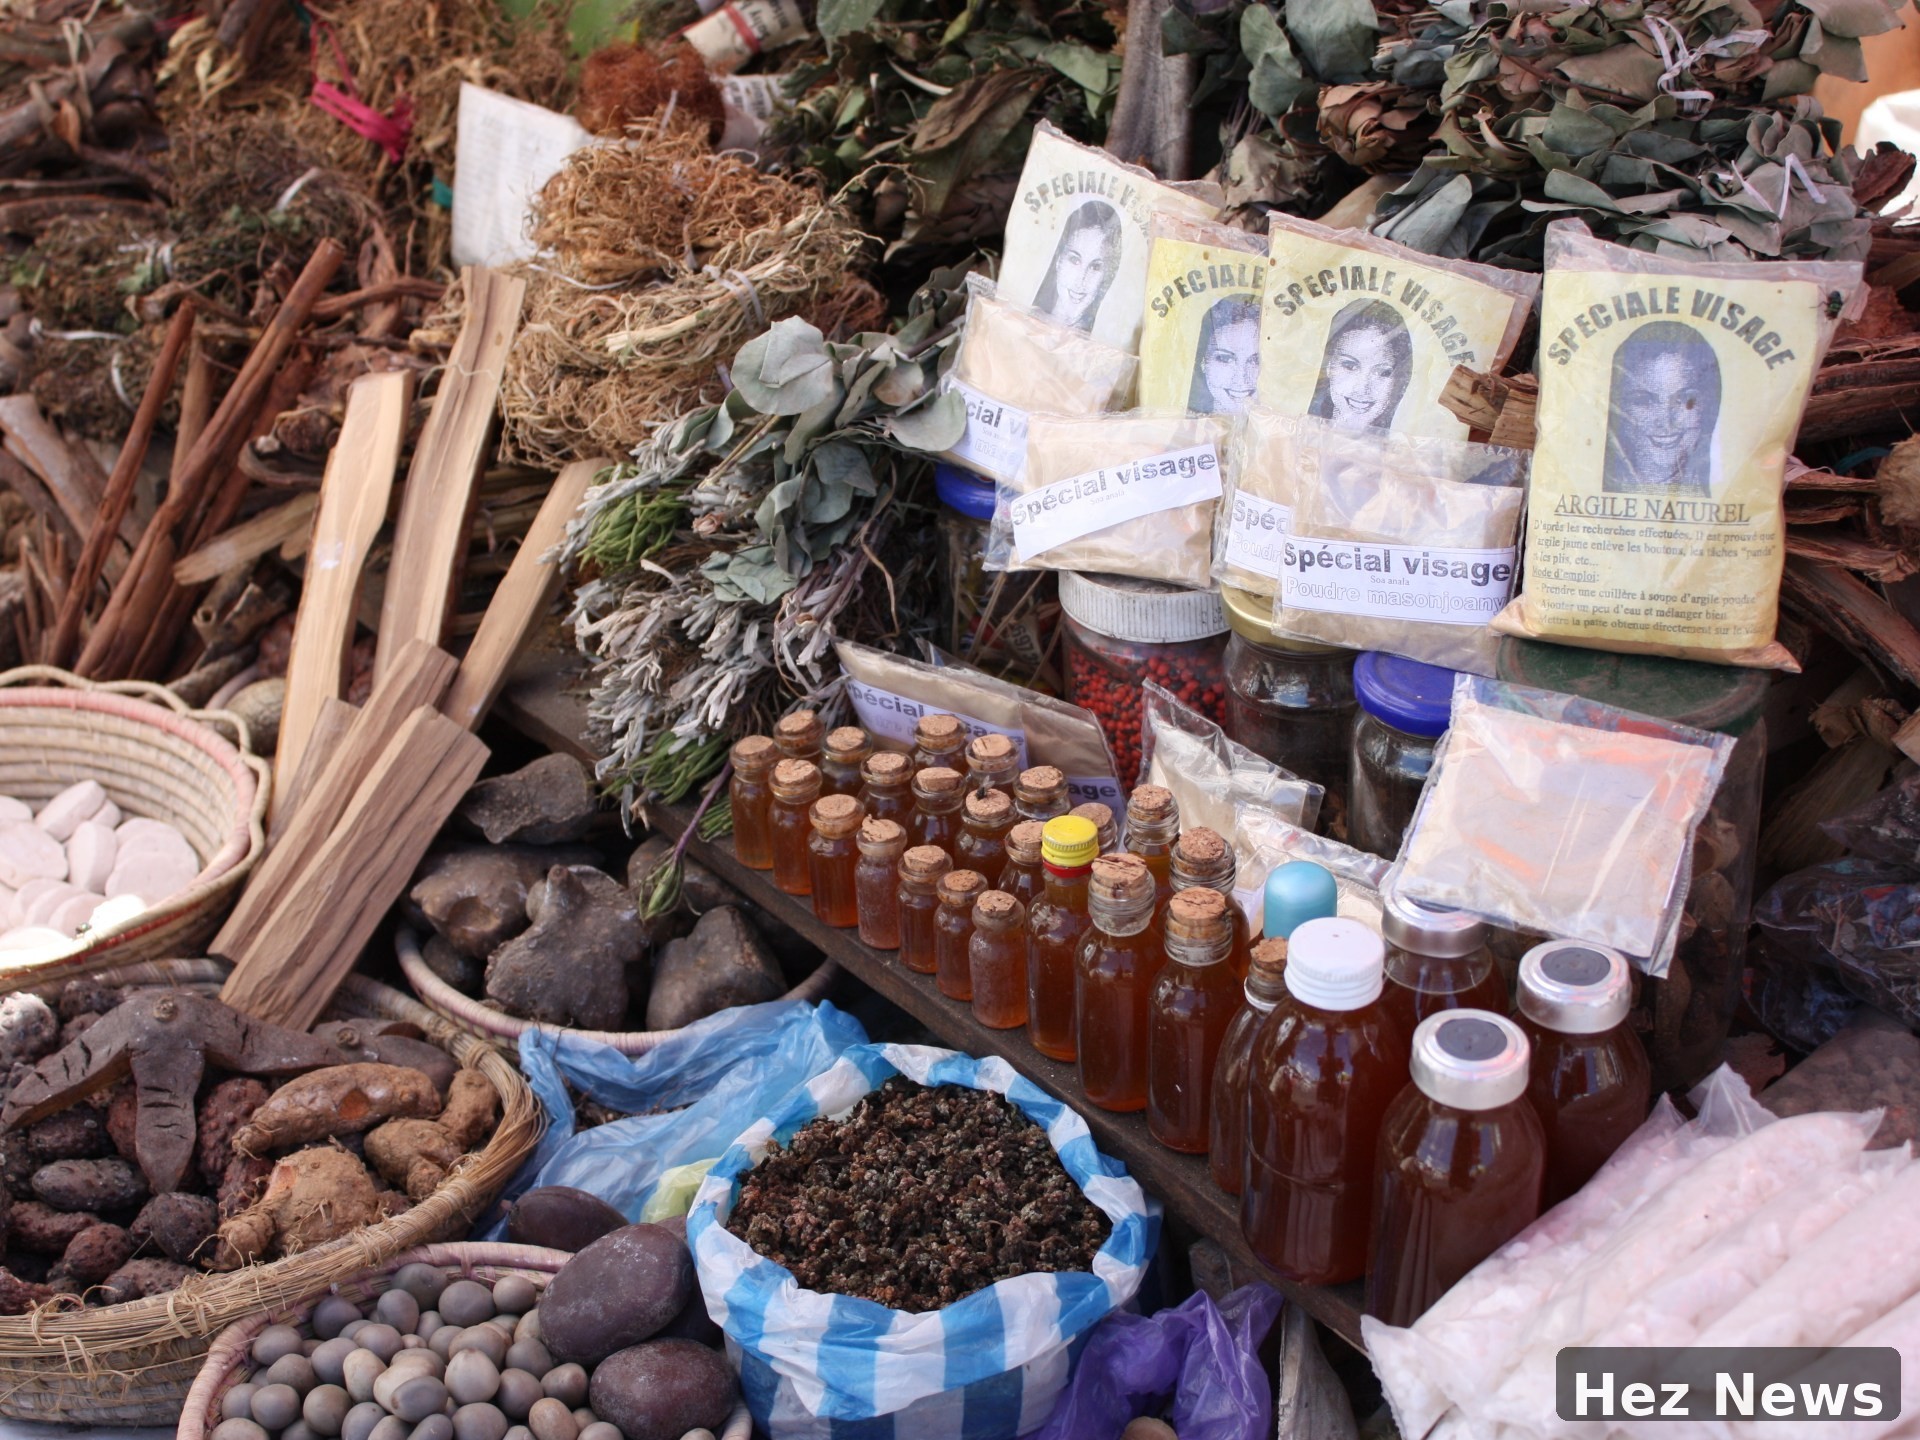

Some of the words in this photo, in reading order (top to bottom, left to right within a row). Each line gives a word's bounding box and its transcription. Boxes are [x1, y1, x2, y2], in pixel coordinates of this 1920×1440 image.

[1024, 170, 1119, 214] SPECIALE
[1151, 263, 1265, 318] SPECIALE
[1274, 265, 1396, 317] SPECIALE
[1400, 278, 1475, 367] VISAGE
[1547, 286, 1680, 366] SPECIALE
[1690, 289, 1795, 371] VISAGE
[1012, 470, 1108, 526] Spécial
[1116, 453, 1216, 485] visage
[1233, 500, 1289, 534] Spéc
[1553, 494, 1638, 519] ARGILE
[1644, 499, 1751, 524] NATUREL
[1233, 531, 1281, 563] Poudr
[1561, 537, 1588, 550] jaune
[1590, 540, 1624, 552] enlève
[1627, 542, 1641, 552] les
[1690, 545, 1704, 556] les
[1567, 521, 1579, 533] les
[1582, 523, 1636, 537] recherches
[1707, 533, 1721, 541] est
[1723, 531, 1758, 544] prouvé
[1760, 533, 1776, 544] que
[1283, 542, 1391, 573] Spécial
[1402, 551, 1511, 587] visage
[1540, 552, 1551, 562] les
[1286, 576, 1361, 602] Poudre
[1367, 589, 1508, 617] masonjoany
[1370, 575, 1386, 584] Soa
[1387, 577, 1410, 586] anala
[1541, 583, 1576, 596] Prendre
[1578, 589, 1596, 597] une
[1599, 588, 1637, 600] cuillère
[1648, 592, 1678, 604] soupe
[1680, 592, 1720, 606] d'argile
[1541, 600, 1574, 611] Ajouter
[1577, 604, 1589, 612] un
[1592, 605, 1610, 615] peu
[1613, 604, 1641, 616] d'eau
[1644, 607, 1653, 616] et
[1656, 607, 1703, 621] mélanger
[1705, 609, 1727, 620] bien
[1611, 619, 1651, 630] obtenue
[1652, 621, 1712, 634] directement
[1714, 626, 1729, 635] sur
[847, 683, 925, 718] pécial
